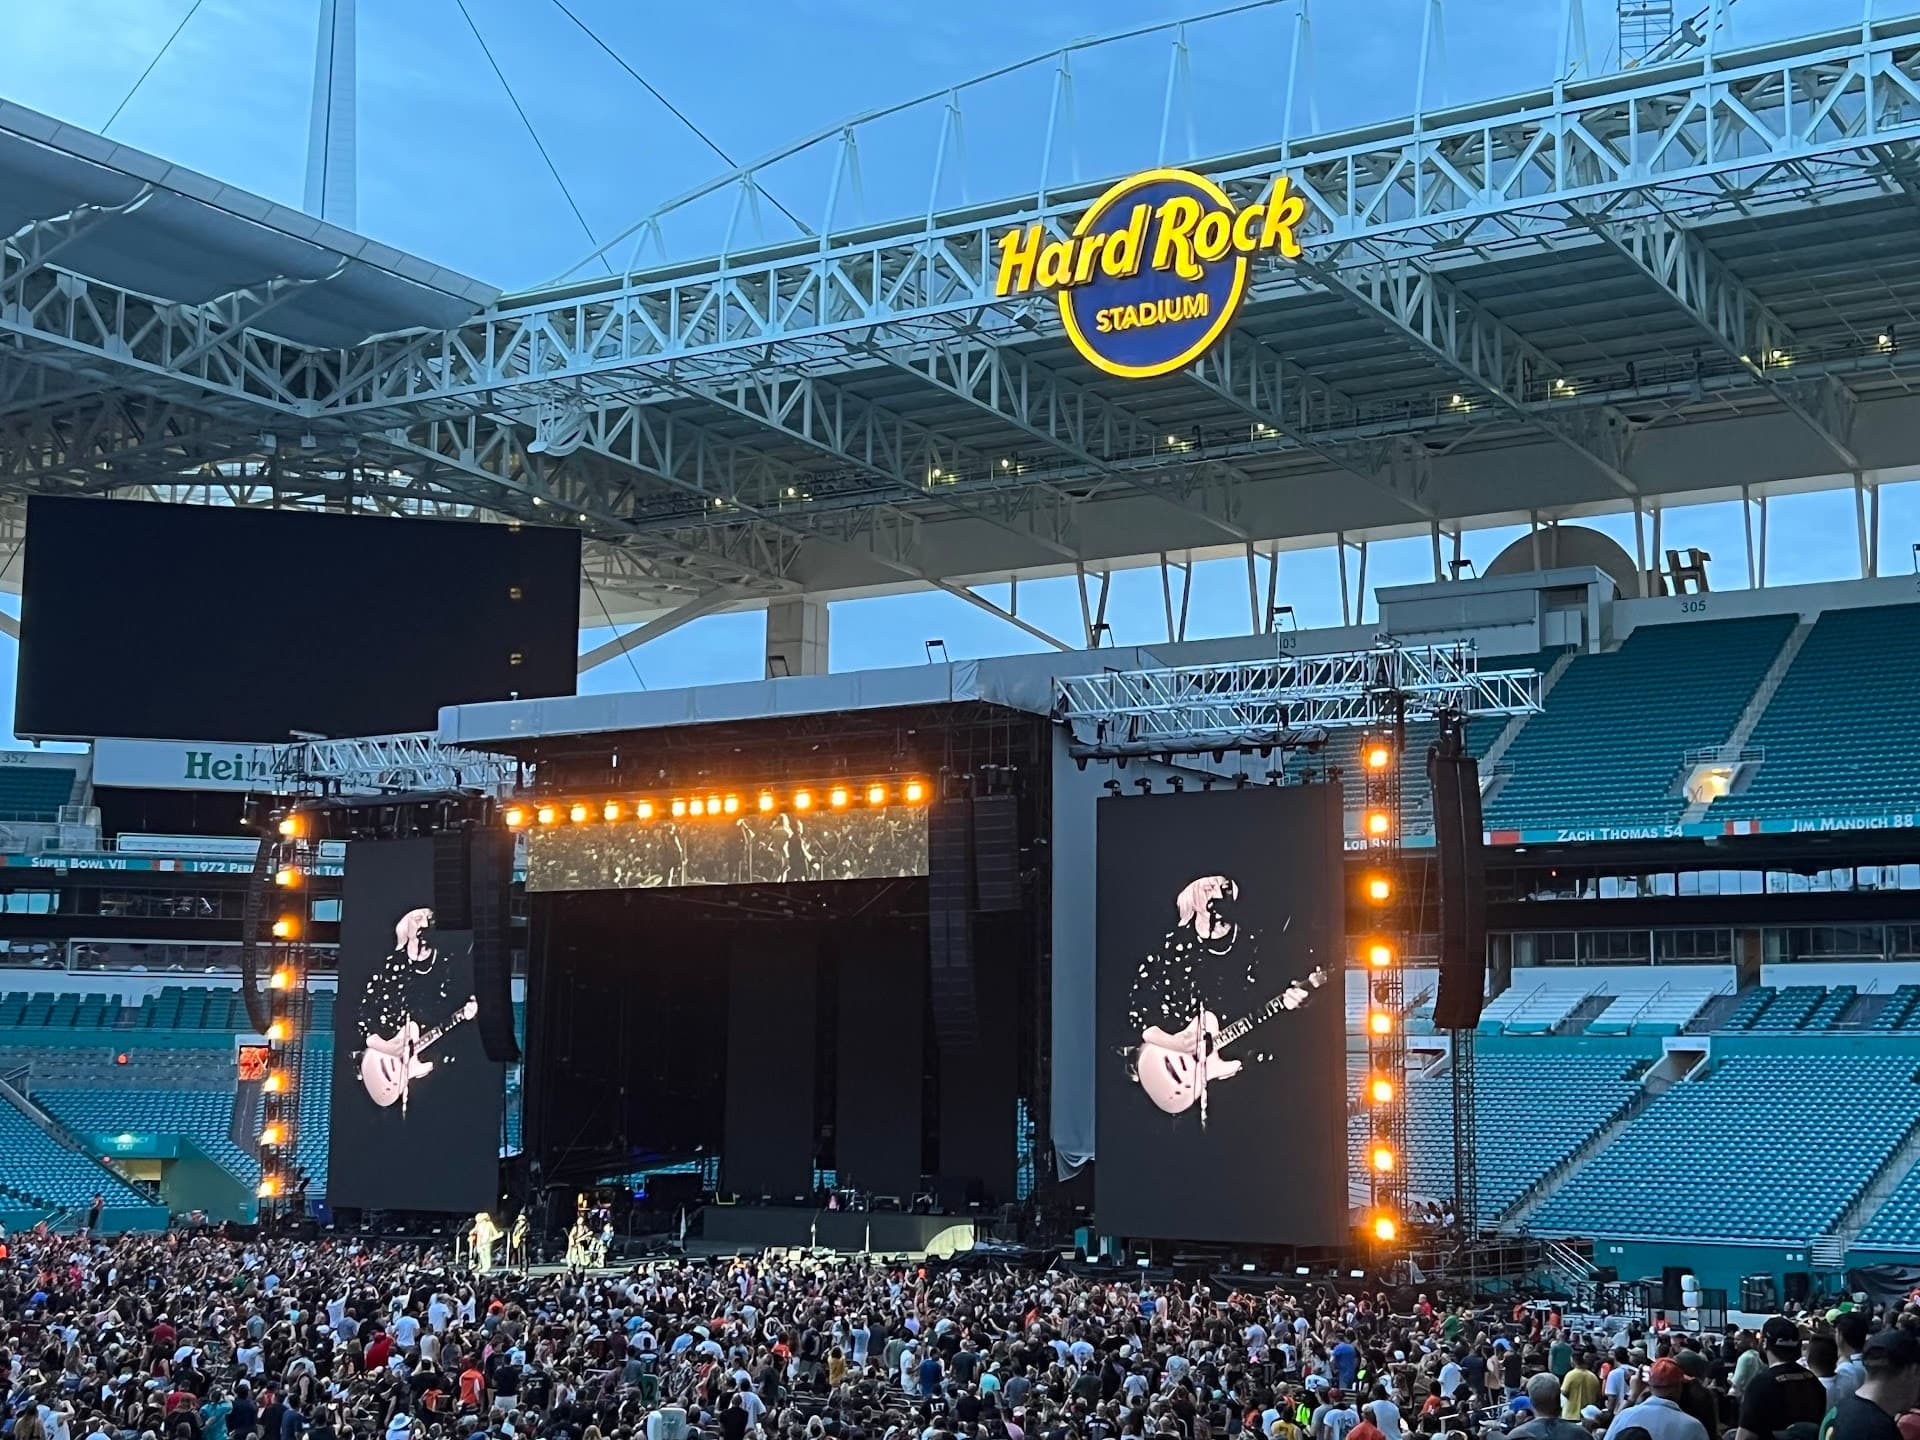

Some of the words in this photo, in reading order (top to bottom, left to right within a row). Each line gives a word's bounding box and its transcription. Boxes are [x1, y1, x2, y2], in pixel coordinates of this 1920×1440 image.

[995, 204, 1152, 296] Hard
[1152, 177, 1305, 281] Rock
[1096, 293, 1209, 333] STADIUM
[1681, 600, 1706, 613] 305
[1820, 817, 1889, 831] MANDICH
[1894, 814, 1914, 828] 88
[1600, 827, 1659, 840] THOMAS
[1663, 825, 1684, 838] 54
[193, 861, 226, 873] 1972
[325, 865, 345, 876] TEA
